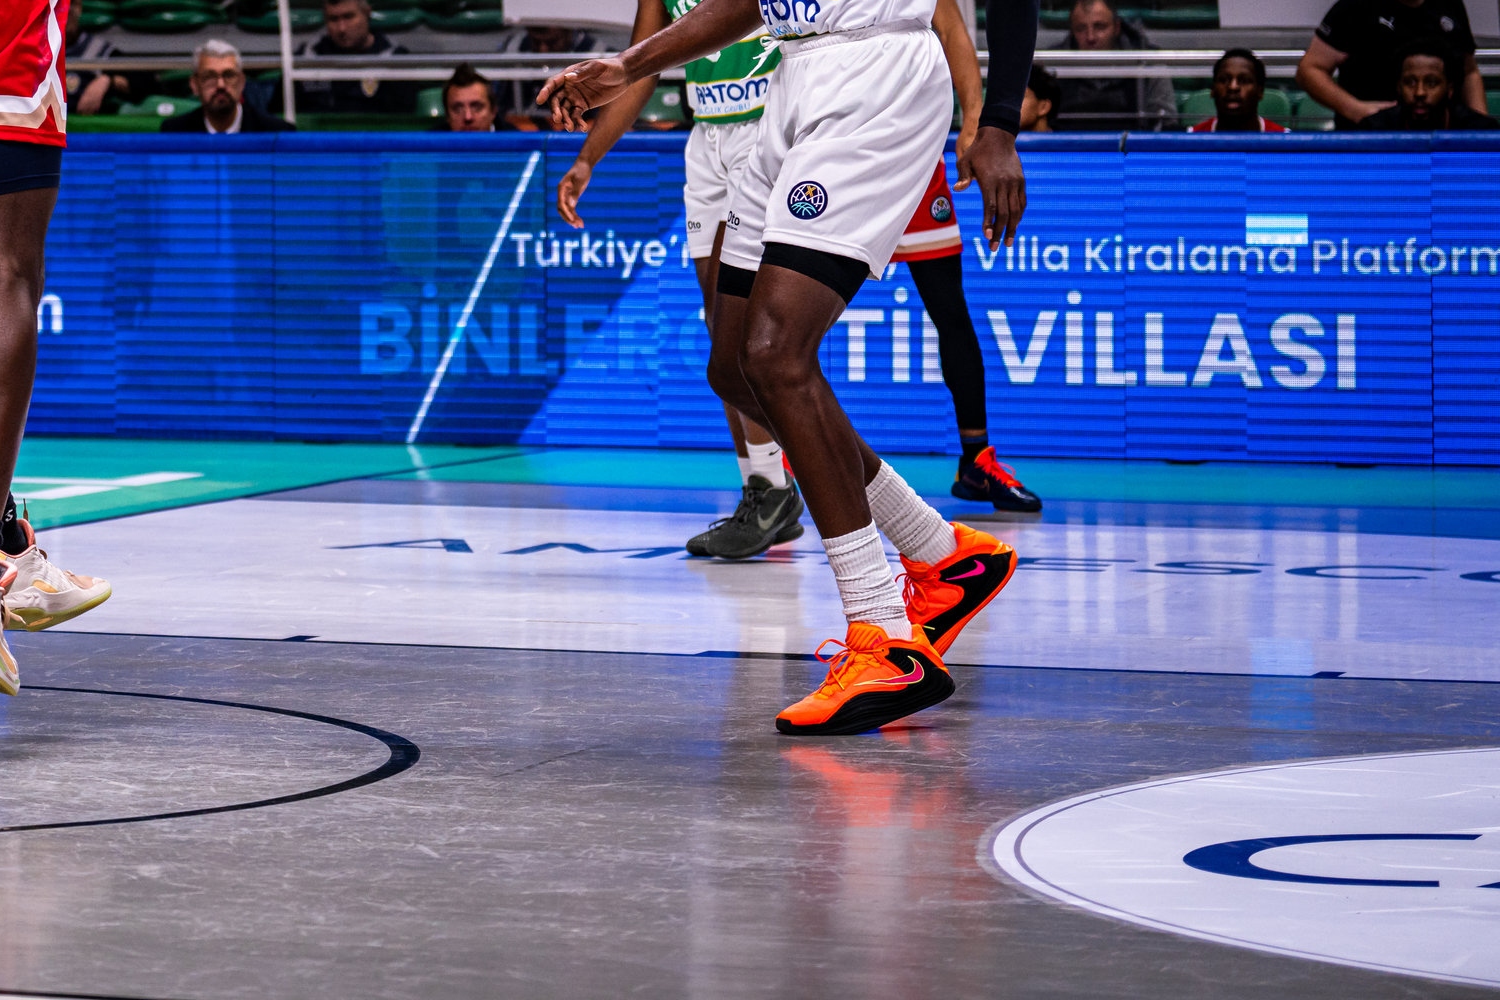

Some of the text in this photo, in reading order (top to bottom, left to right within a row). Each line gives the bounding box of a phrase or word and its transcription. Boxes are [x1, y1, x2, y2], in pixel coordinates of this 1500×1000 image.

[972, 234, 1070, 272] Villa
[1084, 234, 1296, 274] Kiralama
[986, 290, 1357, 390] VİLLASI
